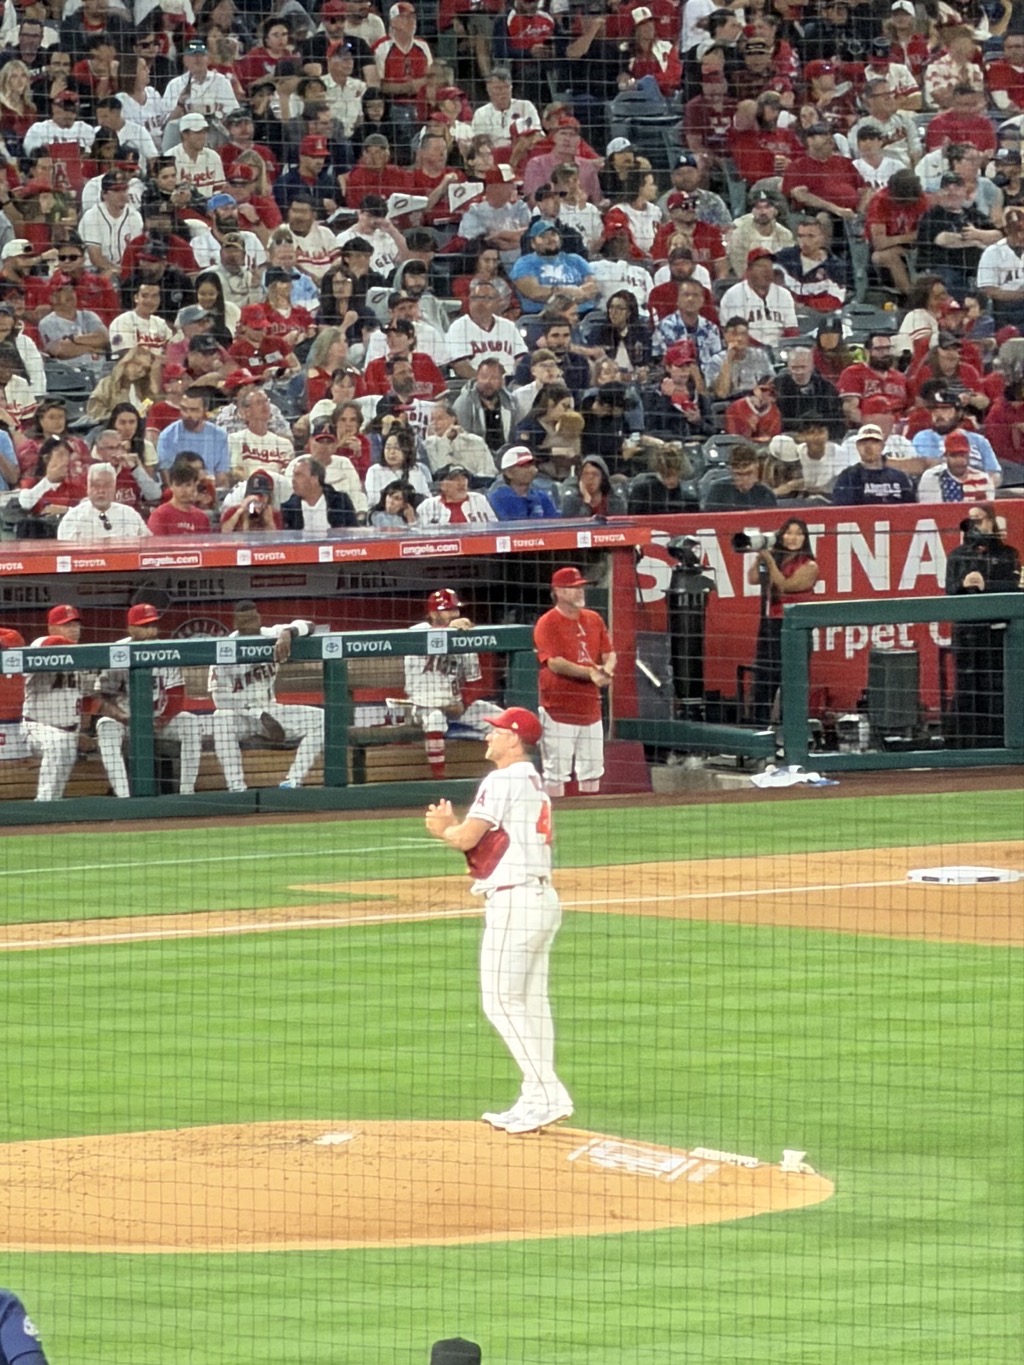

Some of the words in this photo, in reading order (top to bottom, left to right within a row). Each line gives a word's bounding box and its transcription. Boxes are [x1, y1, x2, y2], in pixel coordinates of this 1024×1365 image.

[513, 538, 545, 547] TOYOTA
[593, 533, 626, 543] TOYOTA
[335, 549, 367, 557] TOYOTA
[402, 543, 459, 554] angels.com
[141, 555, 199, 566] angels.com
[254, 552, 286, 561] TOYOTA
[74, 559, 106, 567] TOYOTA
[346, 640, 392, 652] TOYOTA
[451, 635, 497, 647] TOYOTA
[26, 654, 74, 666] TOYOTA
[134, 649, 181, 661] TOYOTA
